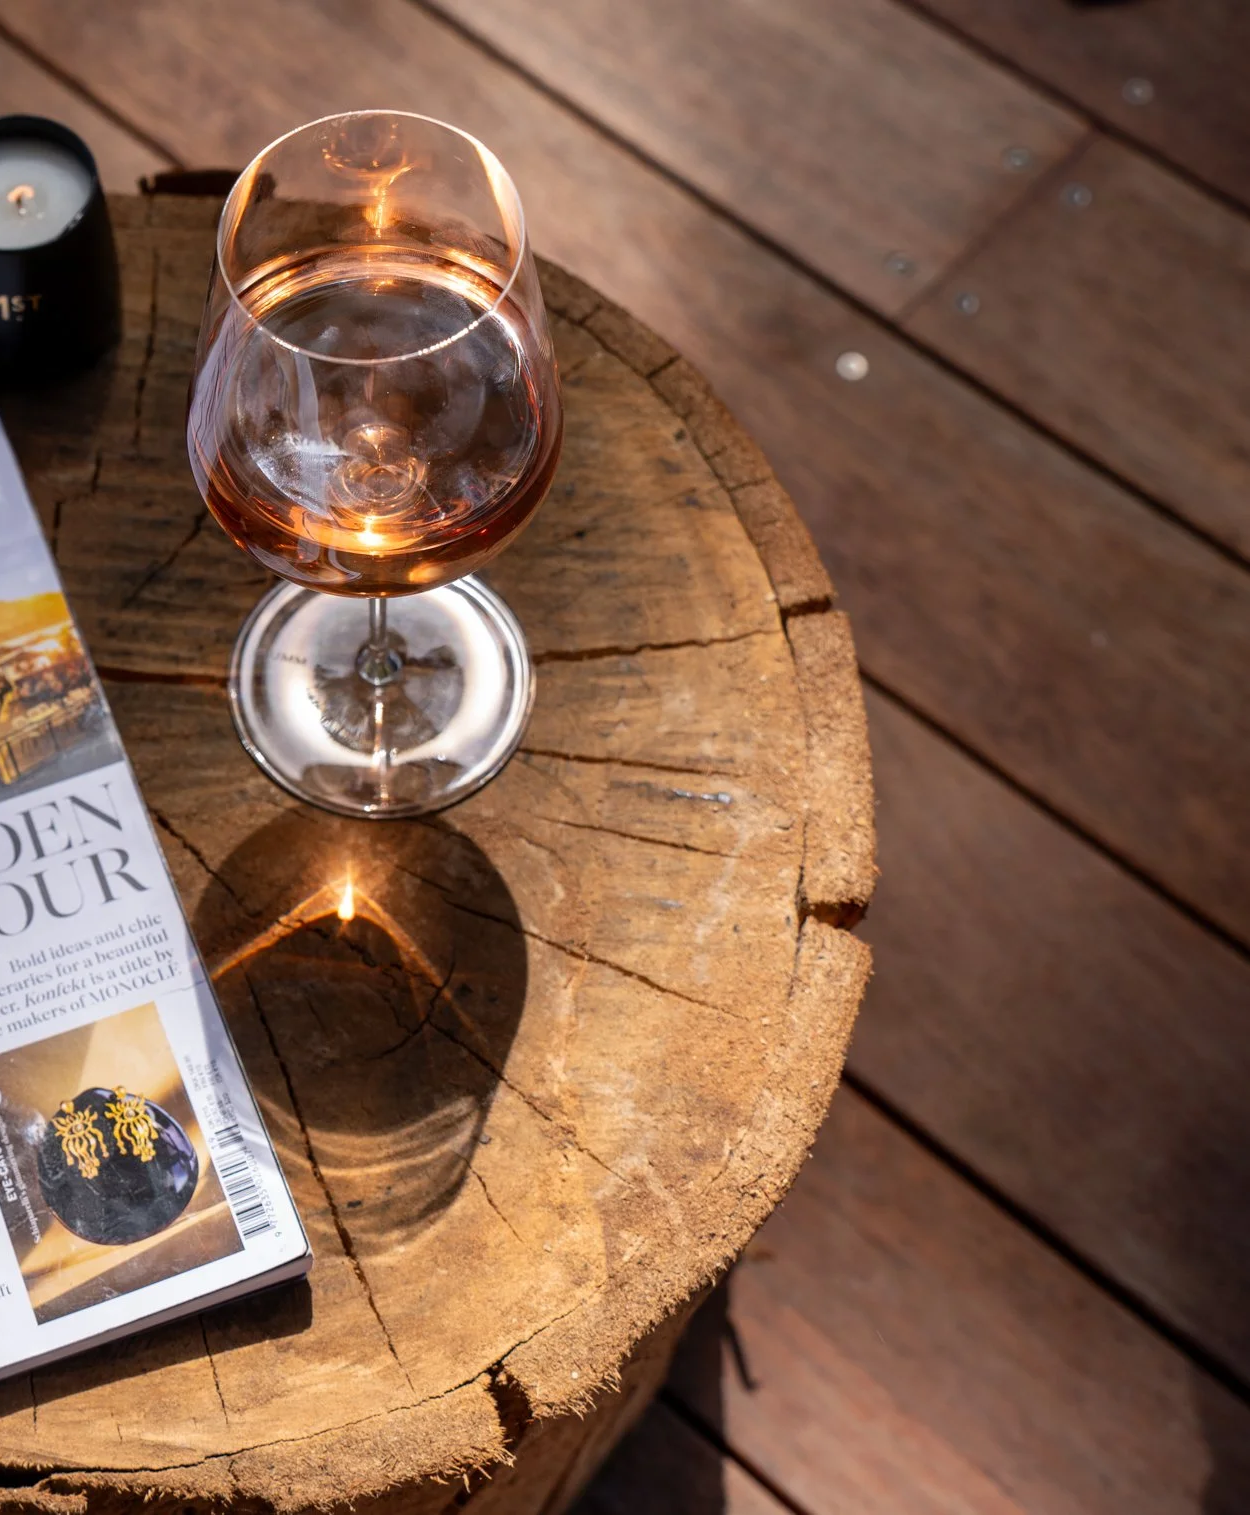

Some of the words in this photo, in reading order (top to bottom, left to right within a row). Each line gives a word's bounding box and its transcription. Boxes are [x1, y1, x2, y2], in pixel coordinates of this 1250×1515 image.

[8, 949, 48, 975] Bold
[47, 939, 93, 961] ideas
[93, 923, 126, 946] and
[127, 913, 162, 934] chic
[54, 960, 80, 978] for
[82, 957, 94, 969] a
[93, 927, 170, 965] beautiful
[24, 976, 87, 1009] Konfekt
[88, 971, 105, 986] is
[105, 967, 118, 980] a
[118, 955, 153, 976] title
[152, 947, 174, 964] by
[5, 1004, 68, 1034] makers
[69, 993, 87, 1012] of
